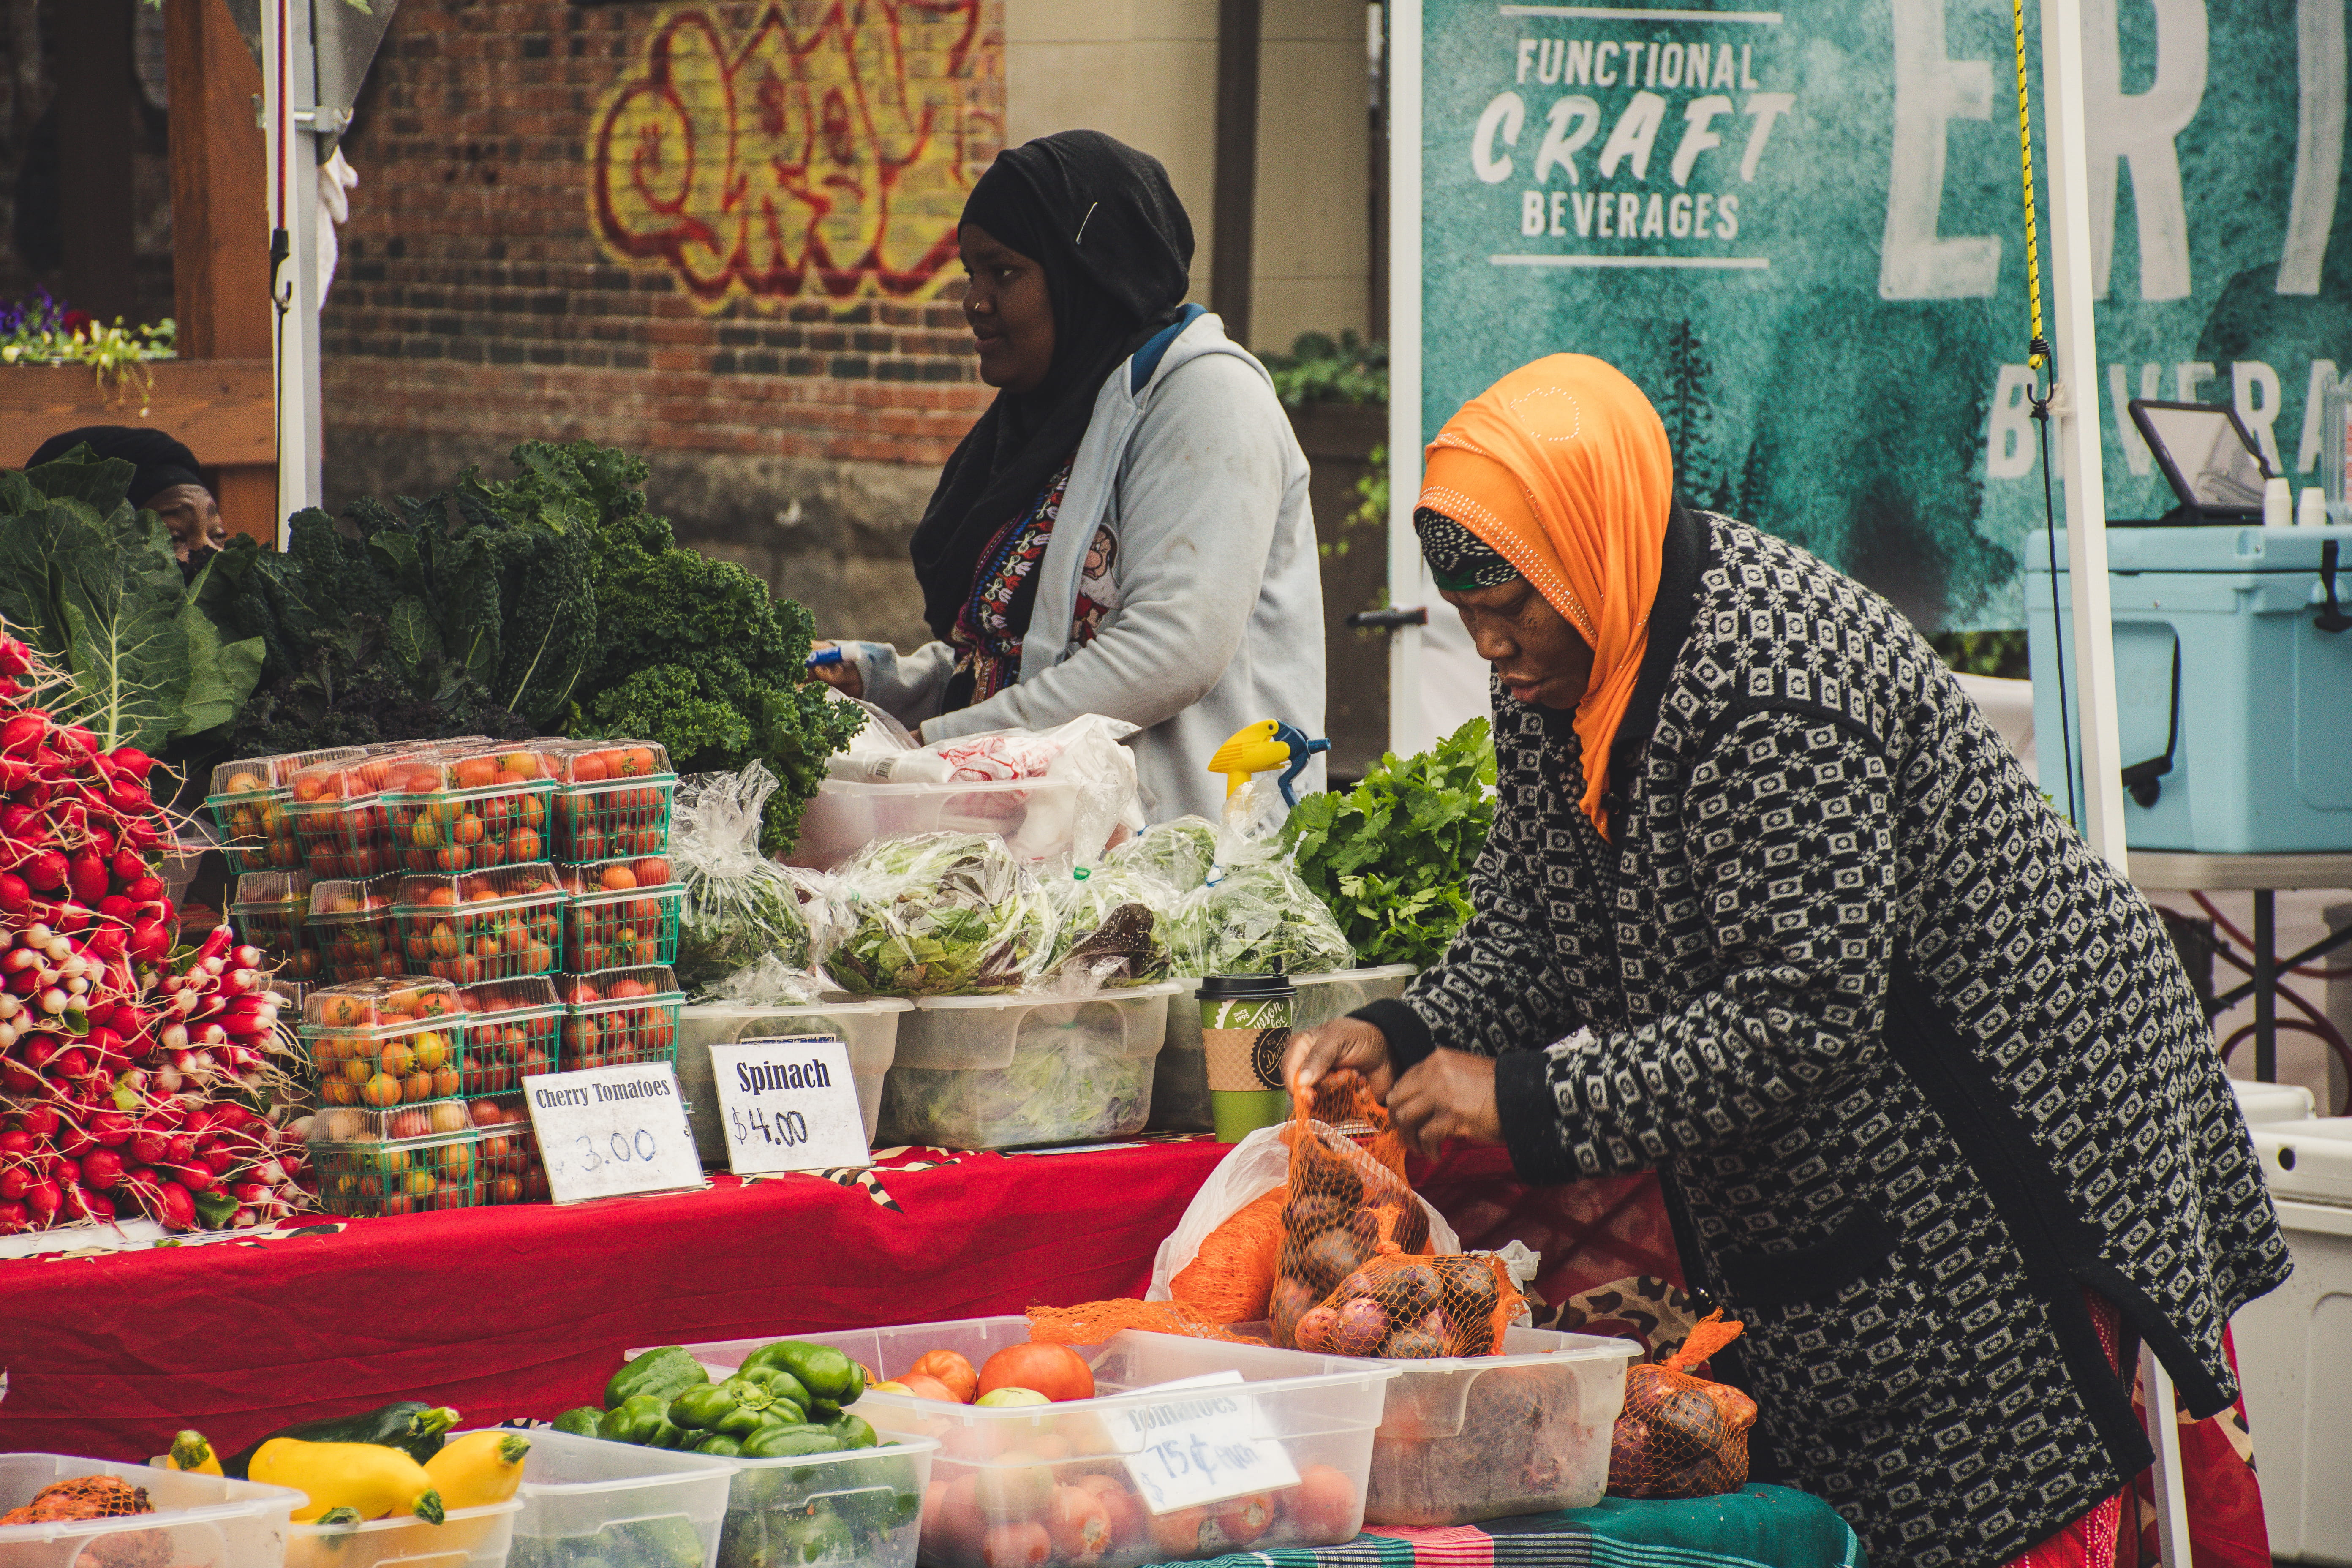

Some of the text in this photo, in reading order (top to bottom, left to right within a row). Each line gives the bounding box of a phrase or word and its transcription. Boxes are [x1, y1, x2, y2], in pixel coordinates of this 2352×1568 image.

[1516, 38, 1759, 90] FUNCTIONAL
[1471, 90, 1797, 188] CRAFT
[1521, 190, 1740, 240] BEVERAGES
[1233, 1008, 1248, 1017] SINCE
[1234, 1013, 1250, 1023] 1995
[535, 1078, 671, 1108] Cherry Tomatoes
[736, 1059, 832, 1095] Spinach
[732, 1107, 808, 1148] $4.00
[576, 1129, 656, 1172] 3.00
